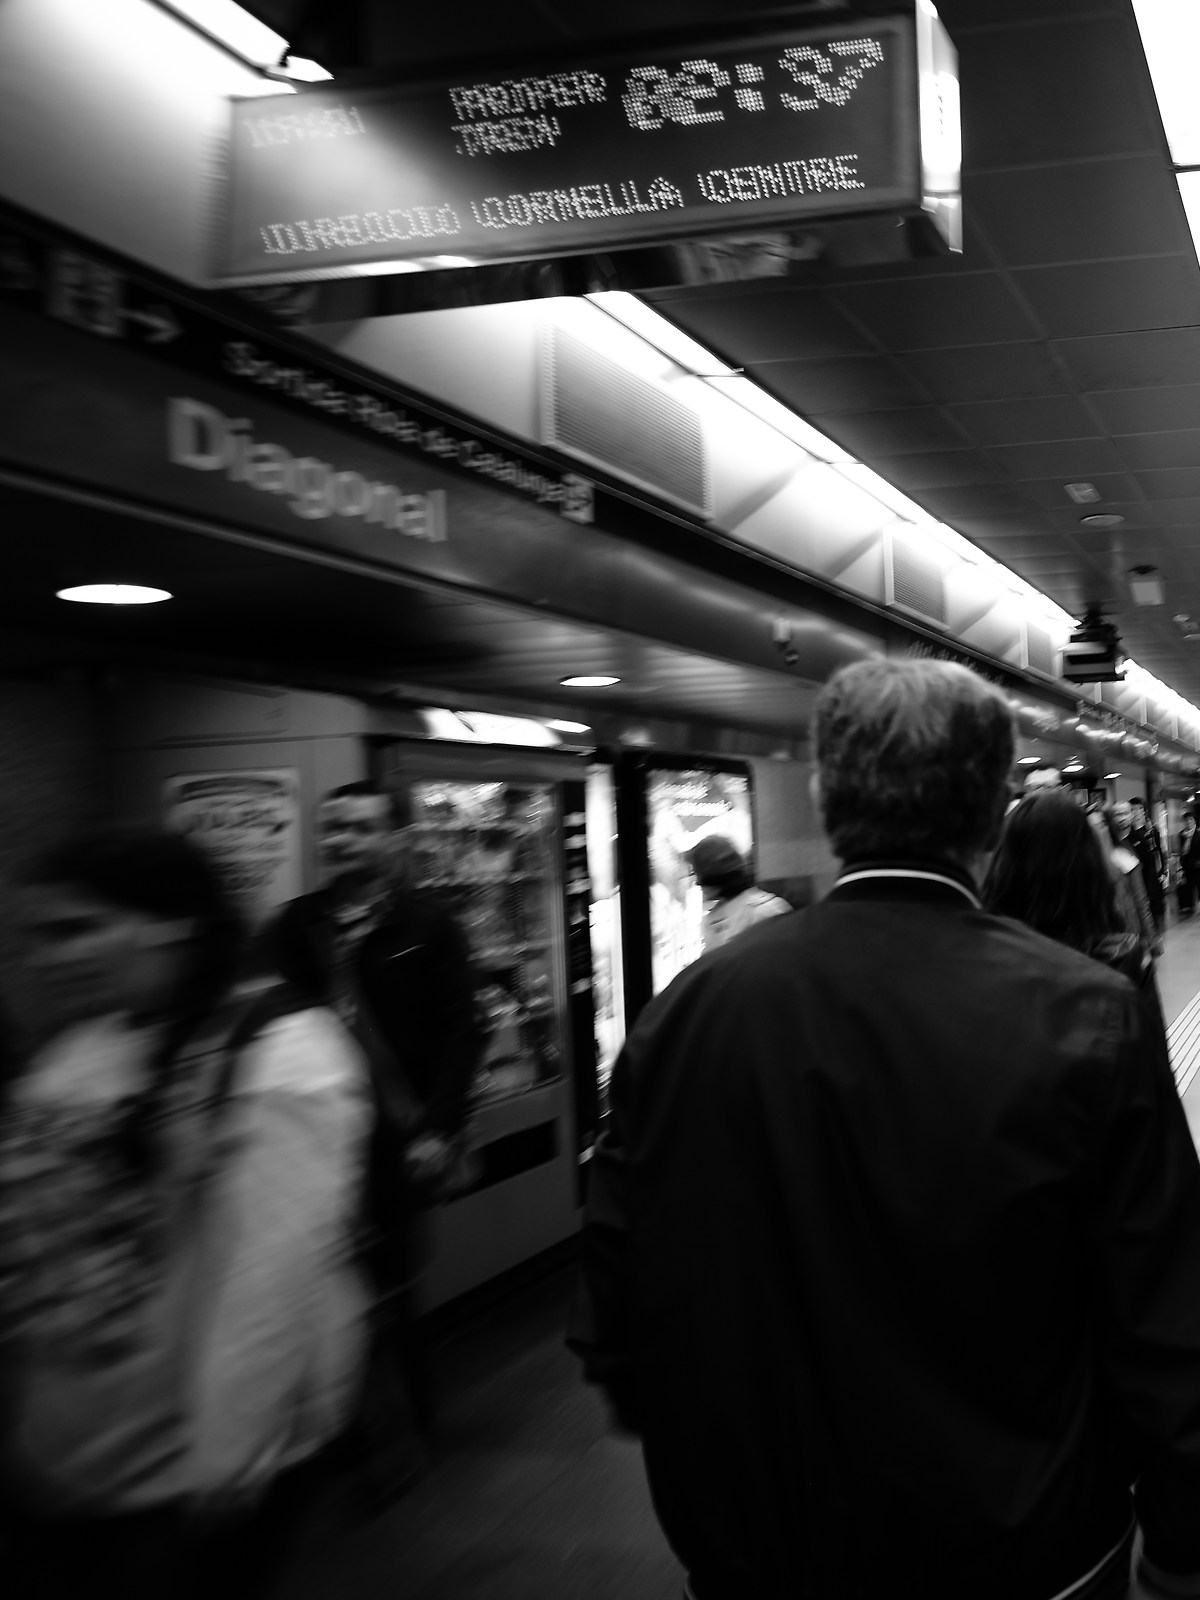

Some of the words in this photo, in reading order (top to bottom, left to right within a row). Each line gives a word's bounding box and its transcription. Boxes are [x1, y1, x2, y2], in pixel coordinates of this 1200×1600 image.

[622, 38, 884, 131] 02:37
[471, 176, 684, 230] CORNELLA
[697, 153, 866, 204] CENTRE
[166, 397, 448, 543] Diagonal
